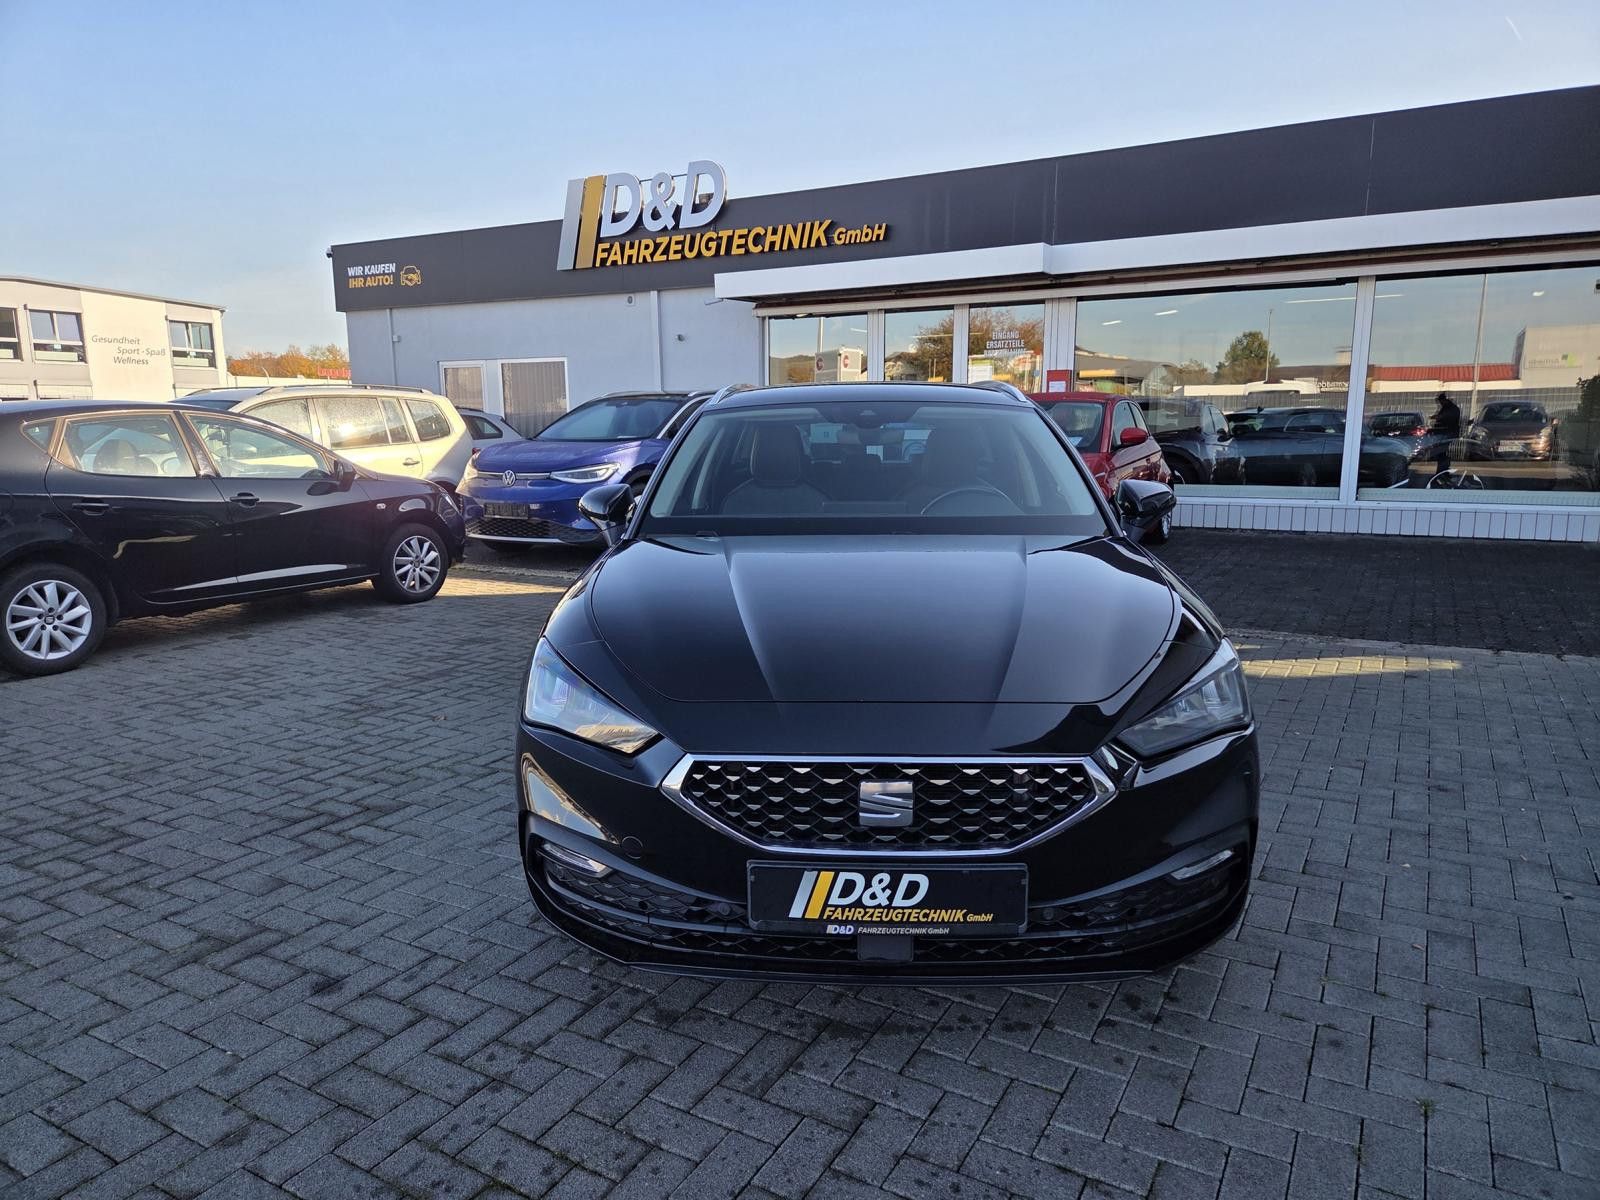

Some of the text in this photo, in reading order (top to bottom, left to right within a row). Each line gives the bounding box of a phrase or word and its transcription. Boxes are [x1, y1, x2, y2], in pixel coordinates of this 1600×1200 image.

[600, 160, 727, 238] D&D
[595, 219, 888, 268] FAHRZEUGTECHNIK GmbH
[347, 262, 396, 277] WIR KAUFEN
[349, 274, 394, 289] IHR AUTO!
[92, 334, 141, 345] Gesundheit
[986, 339, 1025, 349] ERSATZTEILE
[117, 346, 140, 355] Sport
[113, 356, 149, 365] Wellness
[827, 871, 929, 907] D&D
[823, 907, 993, 922] FAHRZEUGTECHNIK GmbH
[832, 925, 854, 935] D&D
[857, 926, 928, 935] FAHRZEUGTECHNIK
